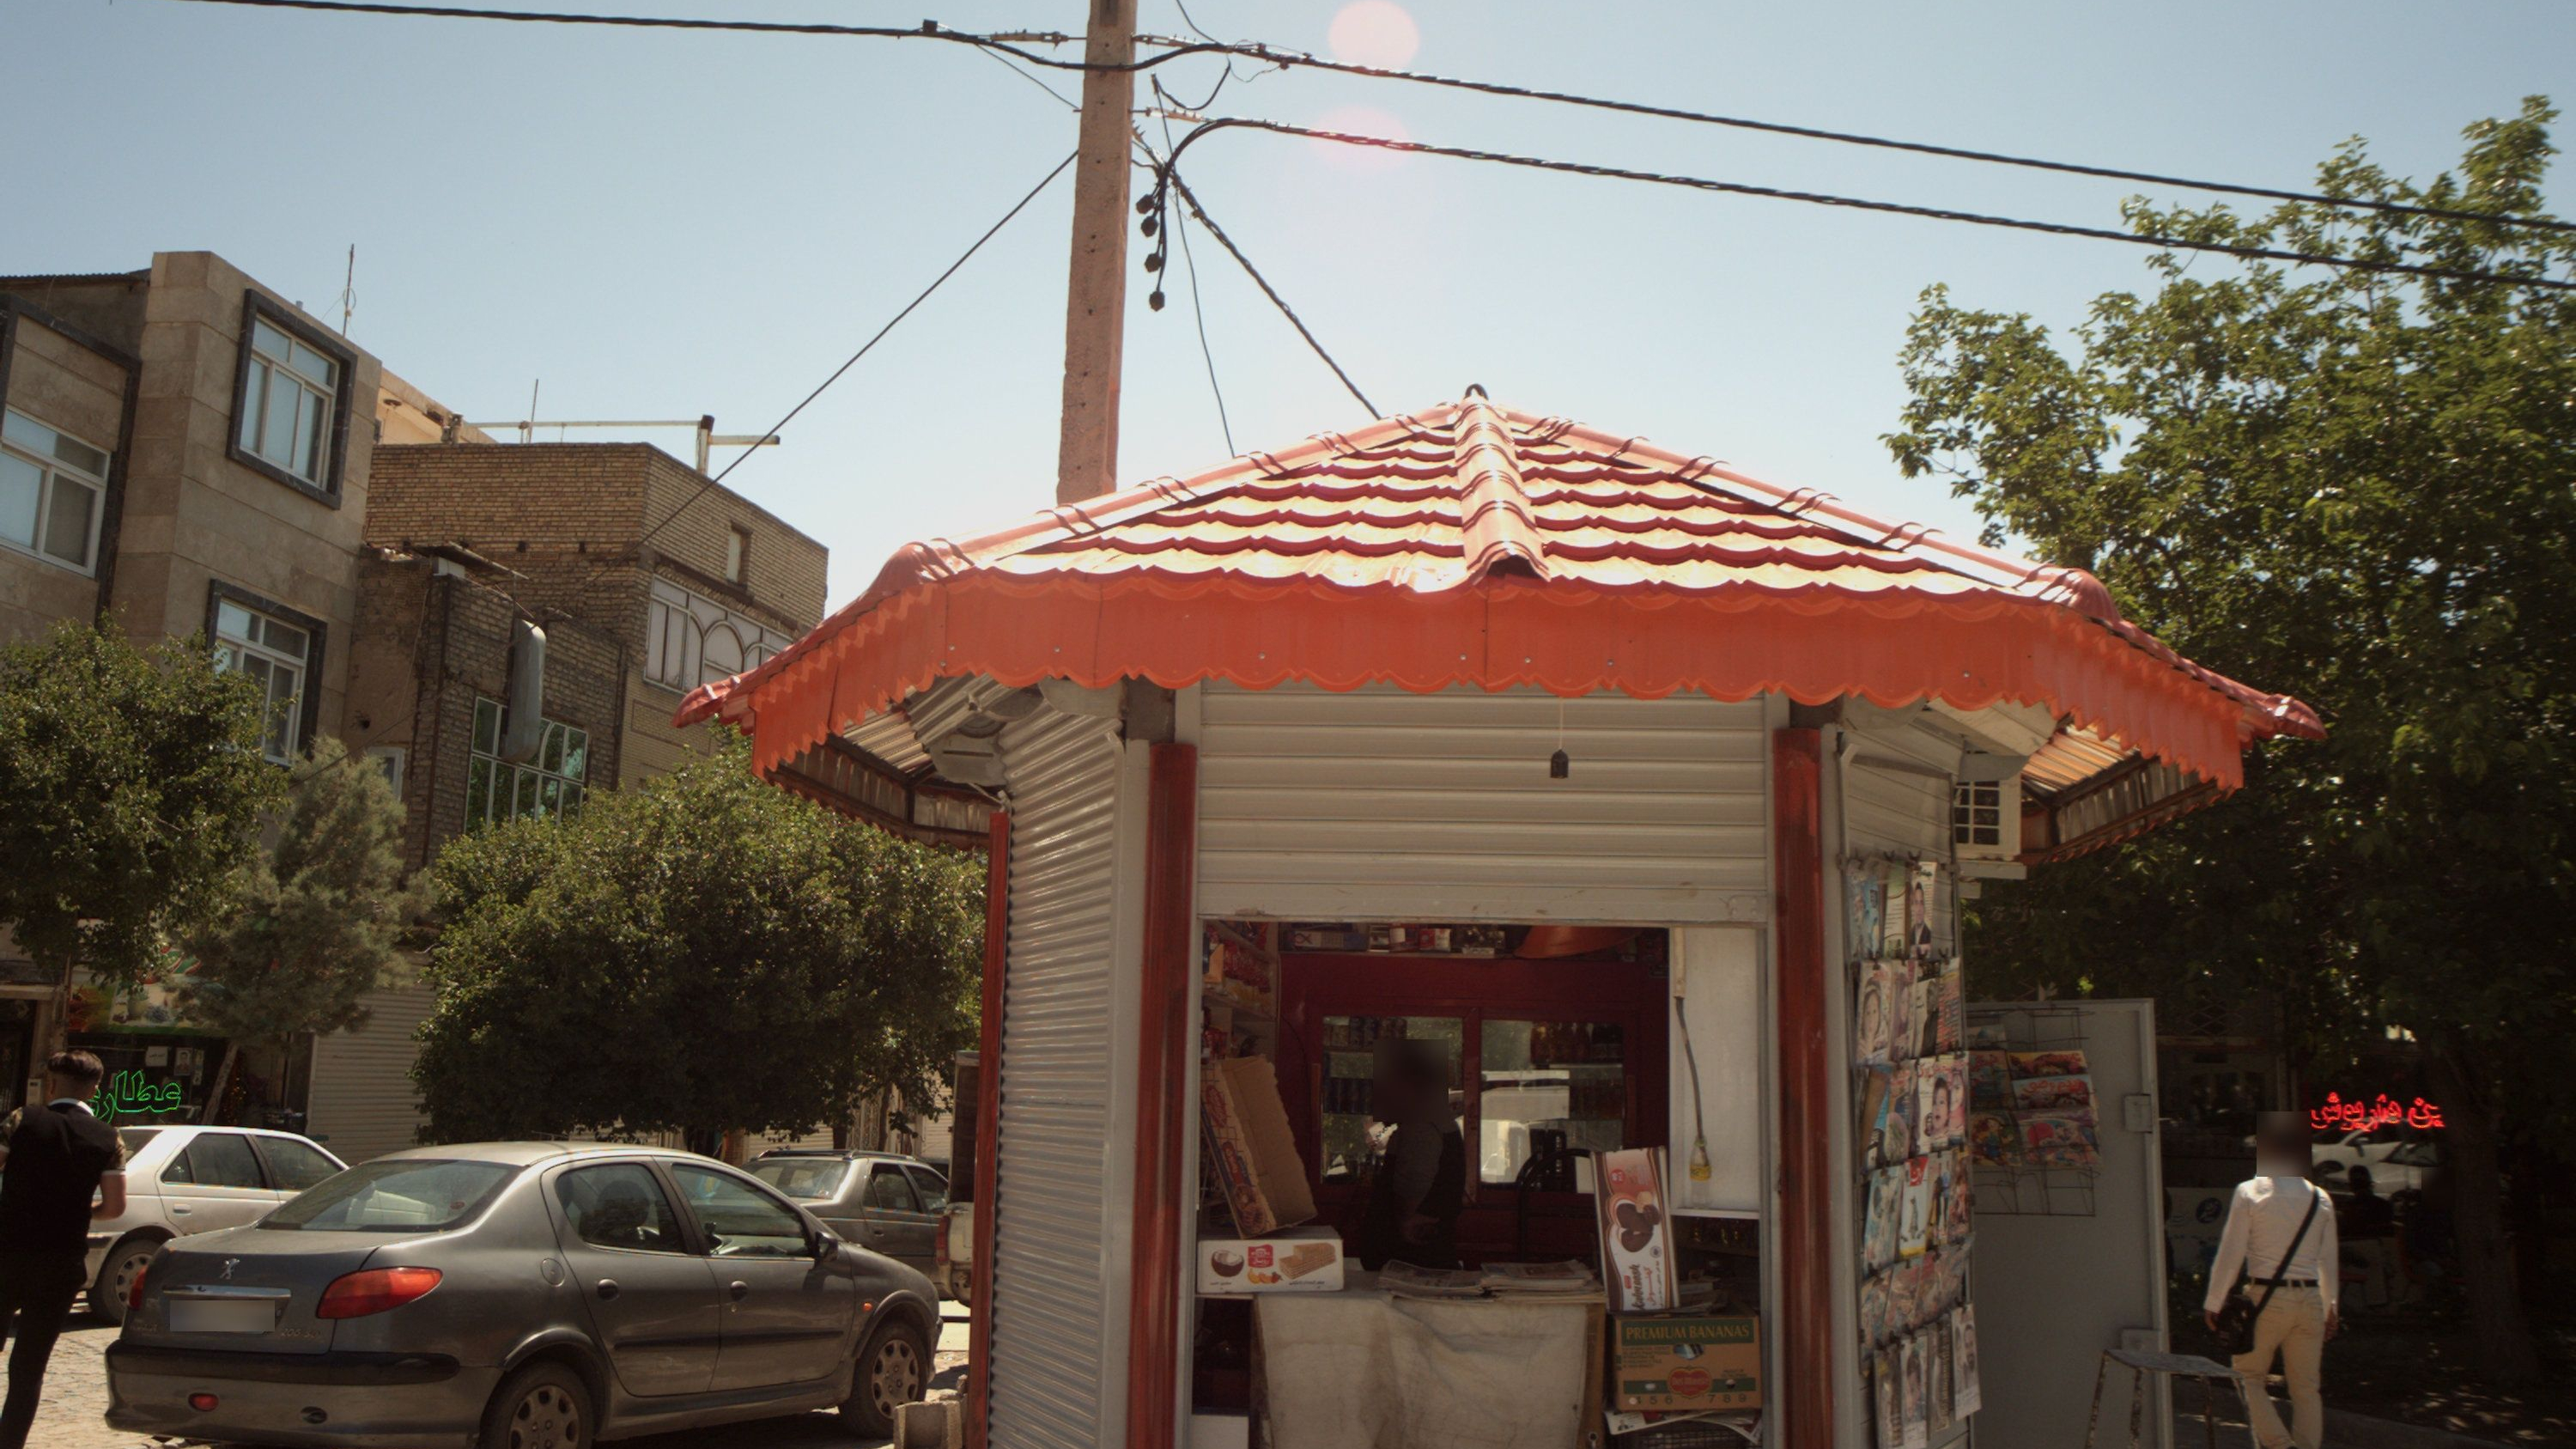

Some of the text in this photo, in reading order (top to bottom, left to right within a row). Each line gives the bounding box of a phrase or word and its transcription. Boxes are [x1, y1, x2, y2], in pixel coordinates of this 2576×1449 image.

[281, 1328, 301, 1337] 206
[1625, 1324, 1749, 1340] PREMIUM BANANAS
[1649, 1396, 1657, 1404] 5
[1665, 1396, 1673, 1404] 6
[1708, 1395, 1716, 1403] 7
[1722, 1394, 1731, 1403] 8
[1738, 1393, 1747, 1403] 9
